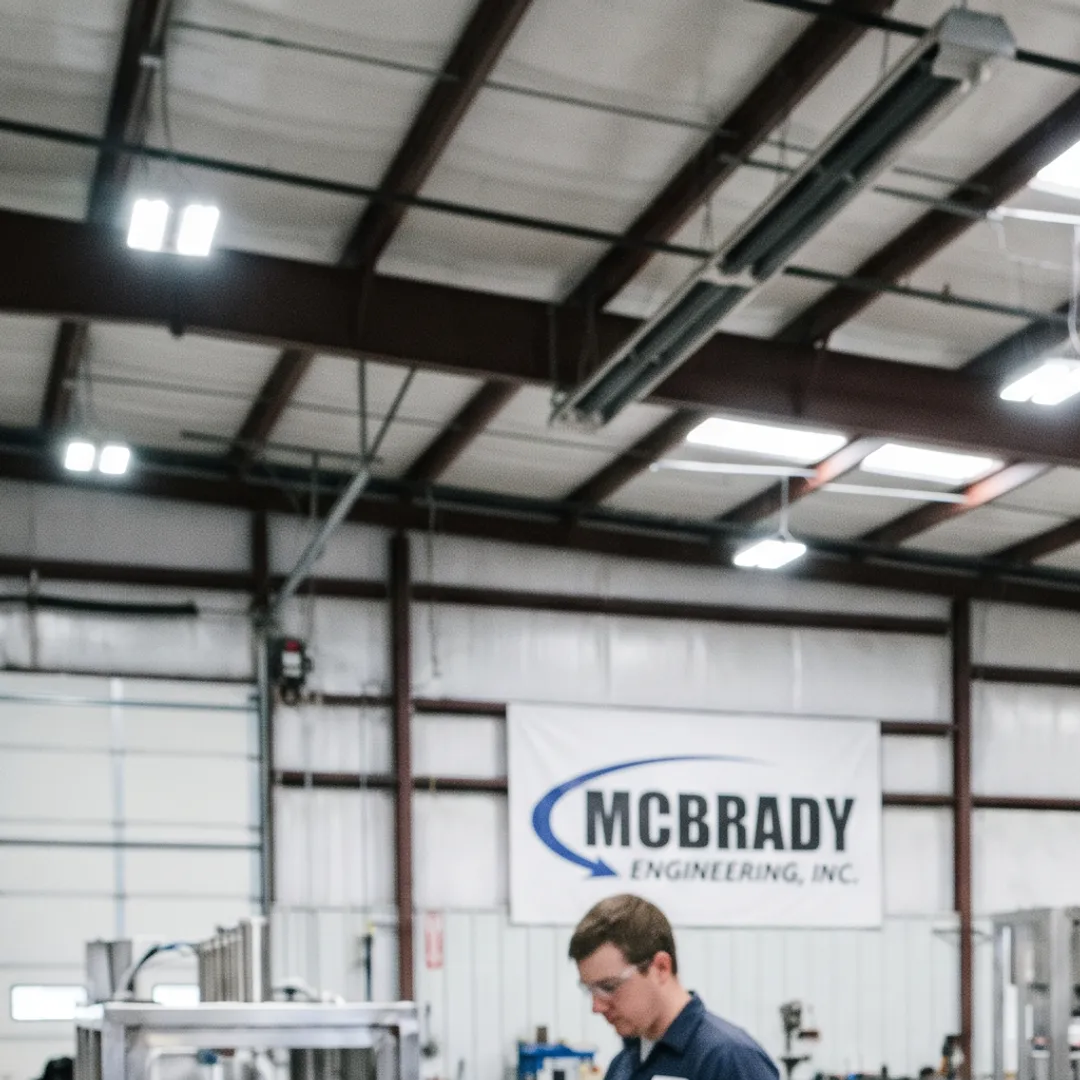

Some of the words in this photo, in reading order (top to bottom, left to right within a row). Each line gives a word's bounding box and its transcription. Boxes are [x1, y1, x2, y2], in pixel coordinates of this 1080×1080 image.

[585, 790, 854, 851] MCBRADY
[631, 858, 804, 886] ENGINEERING,
[812, 863, 859, 885] INC.
